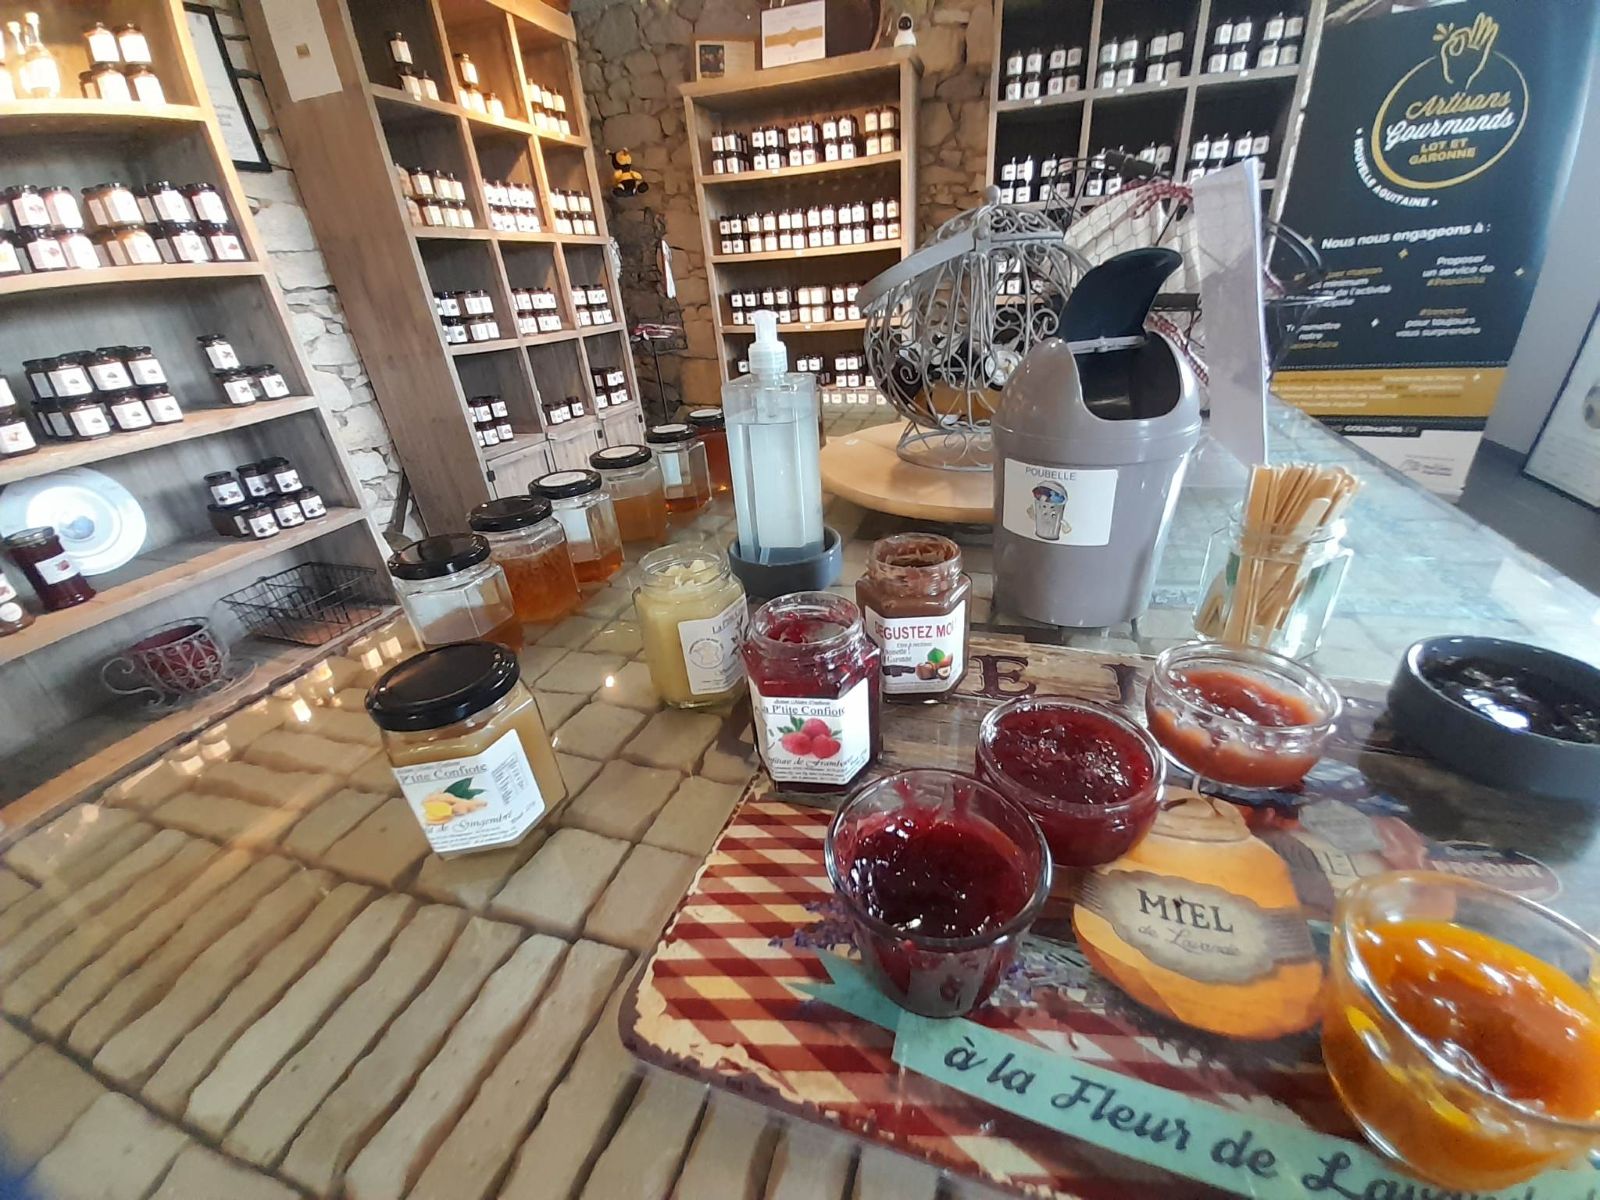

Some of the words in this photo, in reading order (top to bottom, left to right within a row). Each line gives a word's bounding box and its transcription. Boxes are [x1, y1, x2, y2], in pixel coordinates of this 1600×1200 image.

[1405, 91, 1511, 119] Artisans
[1384, 107, 1515, 151] Gourmands
[1408, 147, 1477, 165] GARONNE
[1420, 141, 1447, 153] LOT
[1449, 137, 1469, 149] ET
[1354, 137, 1377, 188] NOUVELLE
[1372, 184, 1430, 207] AQUITAINE
[1321, 237, 1355, 249] Nous
[1357, 232, 1391, 245] nous
[1392, 223, 1473, 242] engageons
[1025, 466, 1077, 481] POUBELLE
[1137, 888, 1234, 934] MIEL
[944, 1035, 988, 1071] à
[986, 1053, 1036, 1094] la
[1050, 1075, 1191, 1150] Fleur
[1211, 1129, 1279, 1179] de
